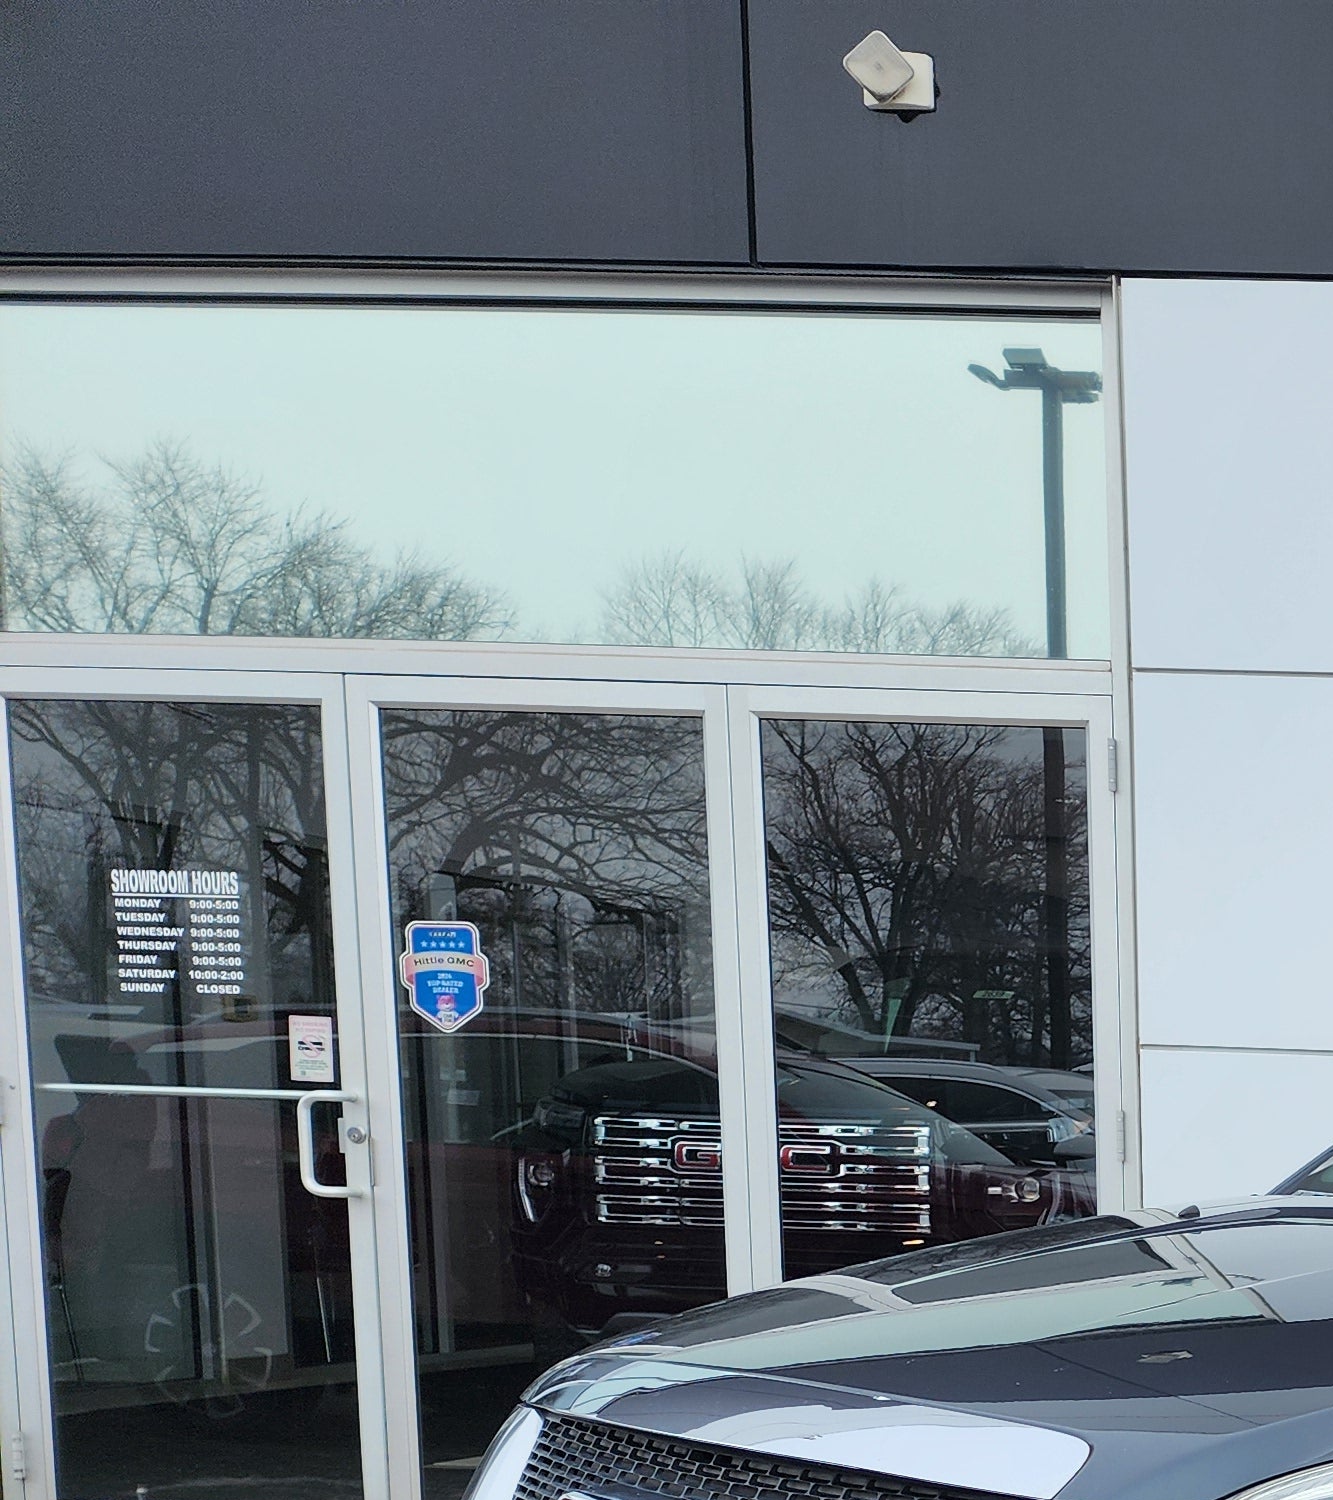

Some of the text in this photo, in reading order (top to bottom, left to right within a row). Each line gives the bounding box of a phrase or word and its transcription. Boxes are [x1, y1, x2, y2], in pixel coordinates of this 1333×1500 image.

[110, 869, 239, 894] SHOWROOM HOURS
[114, 898, 239, 909] MONDAY 9:00-5:00
[115, 912, 240, 923] TUESDAY 9:00-5:00
[116, 926, 240, 938] WEDNESDAY 9:00-5:00
[117, 940, 241, 952] THURSDAY 9:00-5:00
[118, 955, 242, 966] FRIDAY 9:00-5:00
[447, 957, 474, 967] GMC
[118, 968, 244, 980] SATURDAY 10:00-2:00
[120, 983, 240, 994] SUNDAY CLOSED
[674, 1140, 832, 1173] GC
